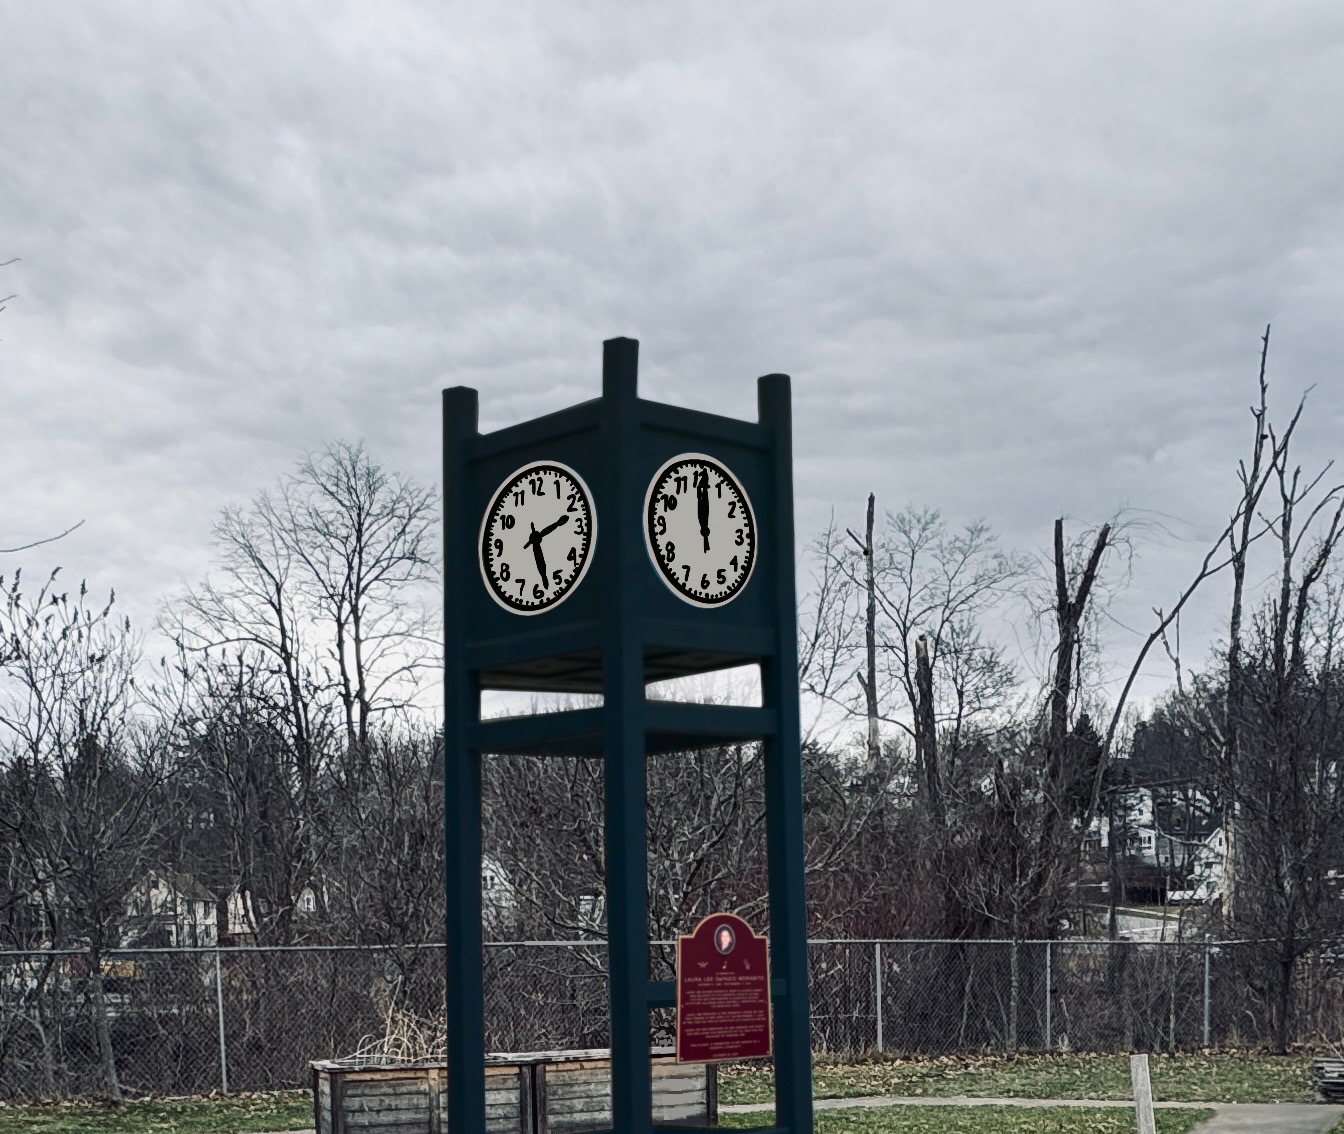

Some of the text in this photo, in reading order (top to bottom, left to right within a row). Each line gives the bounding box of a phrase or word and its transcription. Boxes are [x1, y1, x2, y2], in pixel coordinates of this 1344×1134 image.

[528, 477, 545, 496] 12
[553, 480, 561, 499] 1
[673, 476, 688, 495] 11
[715, 482, 722, 499] 1
[513, 490, 526, 507] 11
[566, 494, 578, 512] 2
[660, 494, 678, 512] 10
[727, 501, 737, 518] 2
[499, 514, 515, 530] 10
[573, 518, 584, 535] 3
[656, 515, 667, 535] 9
[734, 528, 744, 546] 3
[494, 538, 504, 557] 9
[665, 541, 675, 562] 8
[566, 547, 577, 567] 4
[729, 555, 738, 572] 4
[499, 562, 511, 582] 8
[552, 569, 563, 585] 5
[681, 565, 691, 582] 7
[700, 573, 710, 589] 6
[716, 568, 727, 585] 5
[514, 578, 525, 596] 7
[532, 584, 545, 599] 6
